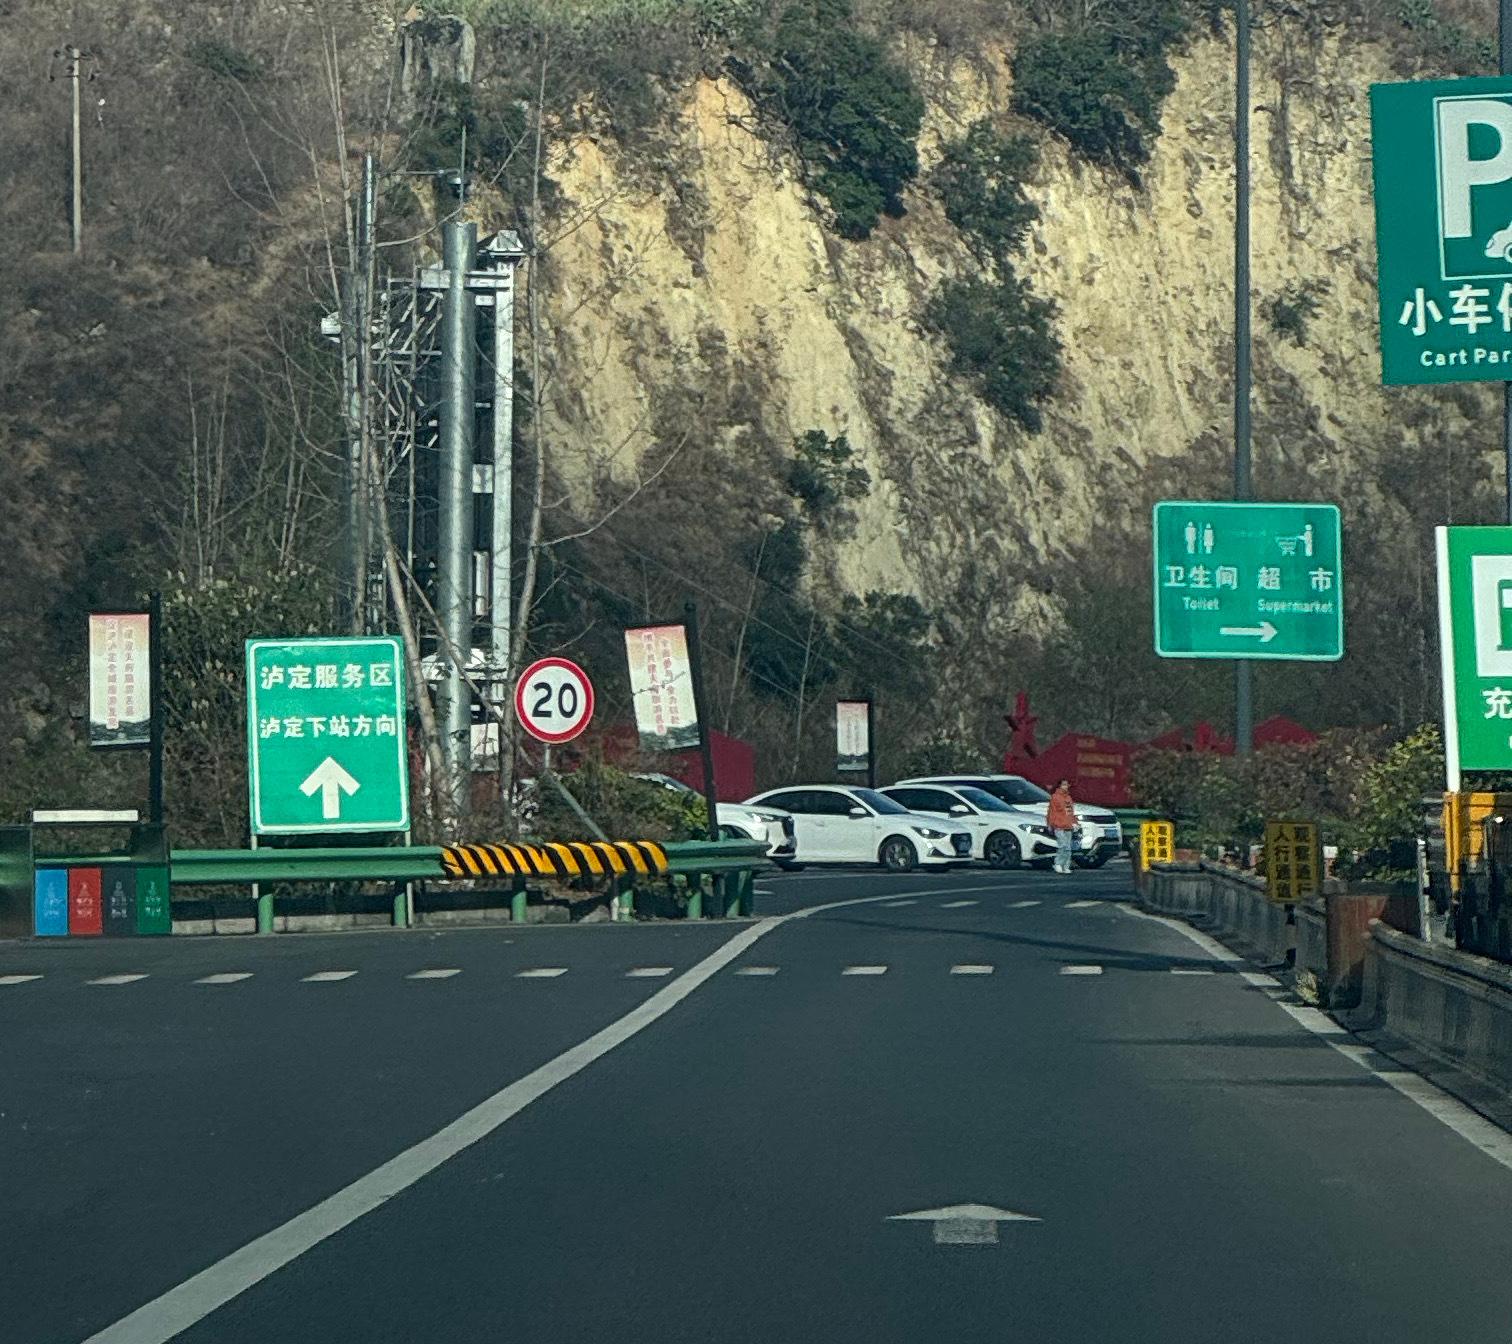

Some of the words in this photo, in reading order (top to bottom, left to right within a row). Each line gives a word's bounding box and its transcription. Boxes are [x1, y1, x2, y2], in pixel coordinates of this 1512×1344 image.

[1420, 349, 1468, 367] Cart
[1163, 565, 1238, 591] 卫生间
[1182, 596, 1220, 612] Toilet
[1257, 598, 1334, 616] Supermarket
[260, 663, 393, 690] 泸定服务区
[532, 681, 578, 719] 20
[260, 714, 396, 739] 泸定下站方向
